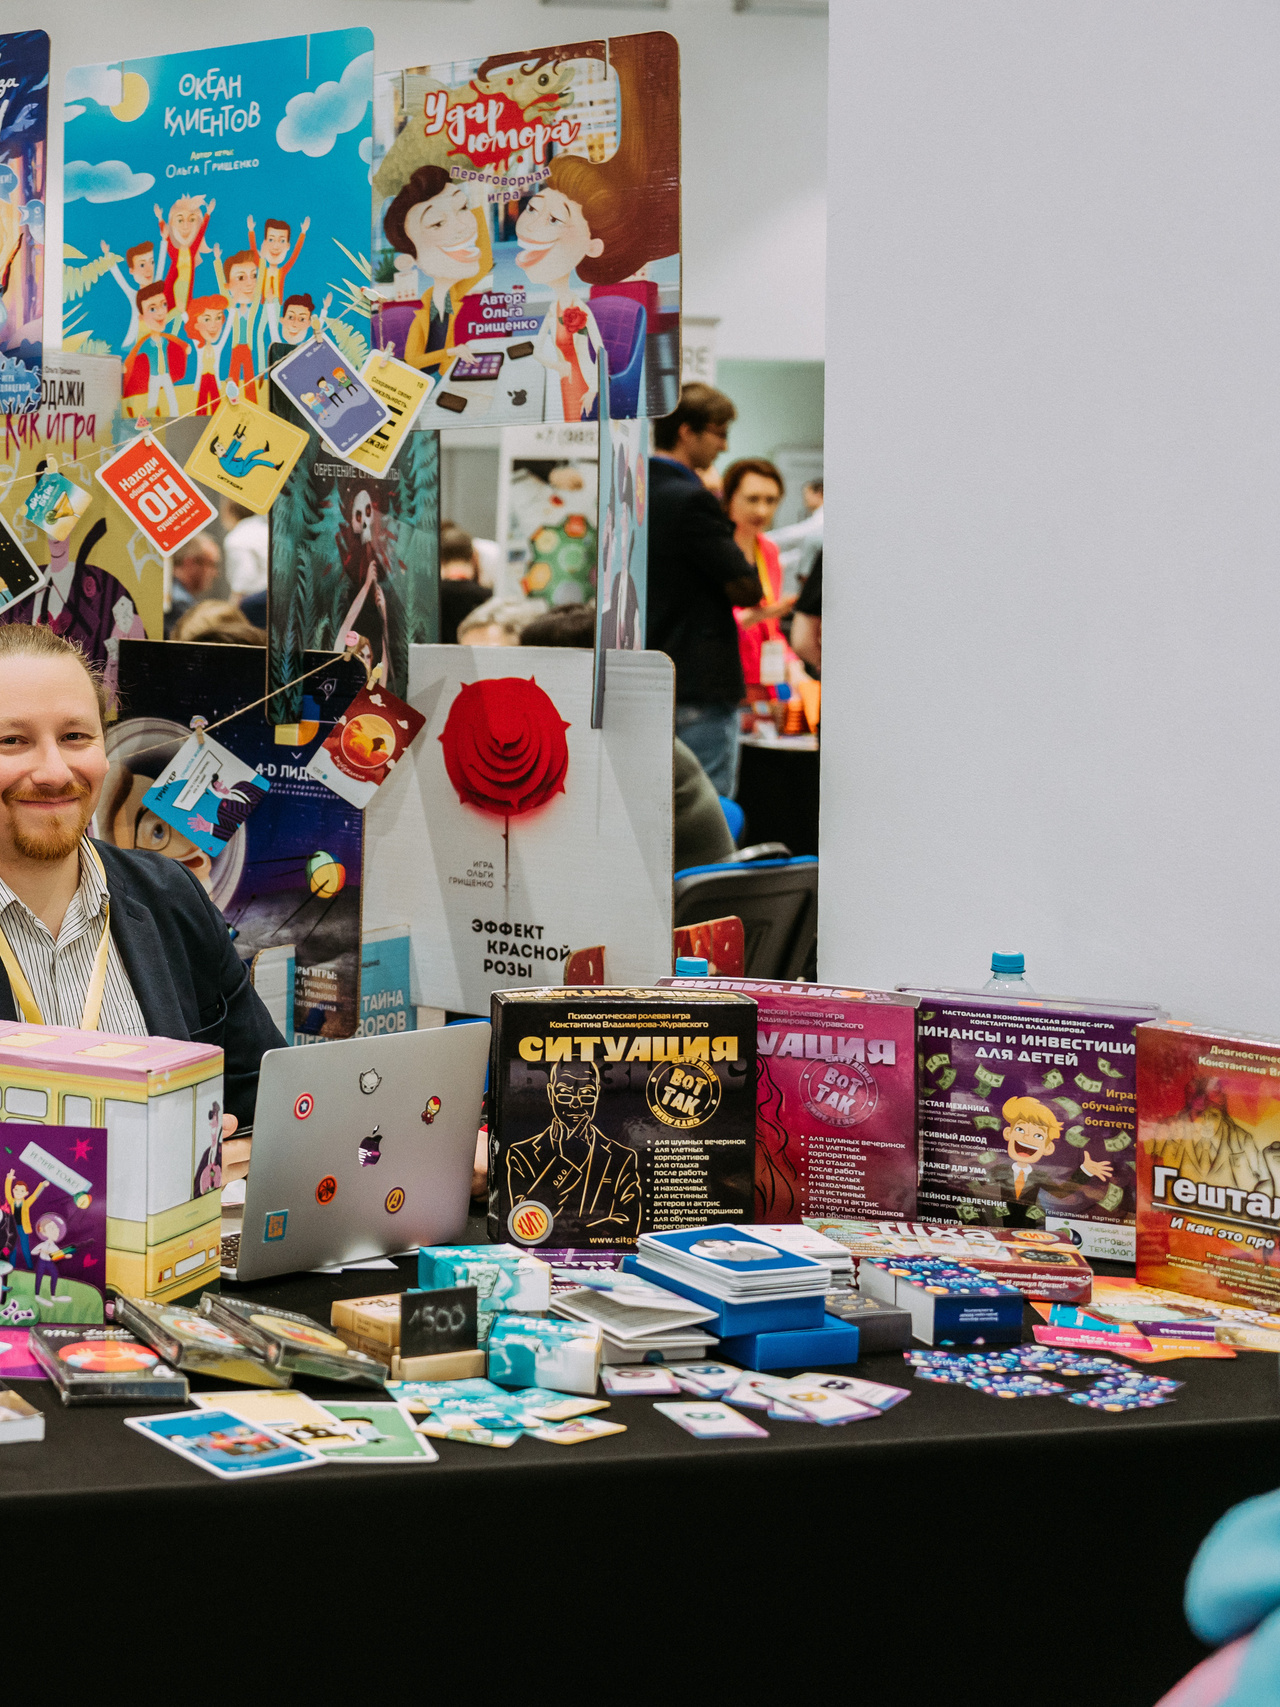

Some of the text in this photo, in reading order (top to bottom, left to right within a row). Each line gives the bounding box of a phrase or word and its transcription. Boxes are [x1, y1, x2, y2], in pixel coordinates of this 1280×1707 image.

[179, 68, 241, 101] ОКЕАН
[164, 101, 261, 137] КЛИЕНТОВ
[424, 90, 504, 145] Удар
[468, 119, 582, 164] юмора
[450, 165, 552, 187] Переговорная
[487, 190, 520, 203] игра
[479, 292, 526, 306] Автор:
[482, 306, 523, 320] Ольга
[468, 319, 538, 335] Грищенко
[42, 380, 85, 410] ОДАЖИ
[118, 457, 159, 492] Находи
[137, 474, 188, 523] ОН
[156, 498, 195, 532] существует!
[155, 771, 177, 801] ТРИГГЕР
[472, 860, 494, 869] ИГРА
[466, 869, 494, 879] ОЛЬГИ
[448, 877, 494, 888] ГРИЩЕНКО
[472, 918, 544, 940] ЭФФЕКТ
[487, 940, 570, 962] КРАСНОЙ
[311, 967, 337, 980] ИГРЫ:
[483, 959, 532, 978] РОЗЫ
[362, 989, 404, 1012] ТАЙНА
[568, 1012, 637, 1020] Психологическая
[789, 1010, 823, 1018] ролевая
[825, 1012, 844, 1020] игра
[942, 1010, 1114, 1029] НАСТОЛЬНАЯ ЭКОНОМИЧЕСКАЯ БИЗНЕС-ИГРА
[602, 1021, 709, 1029] Владимирова-Журавского
[970, 1019, 1085, 1034] КОНСТАНТИНА ВЛАДИМИРОВА
[918, 1026, 1001, 1044] ИНАНСЫ
[518, 1036, 738, 1062] СИТУАЦИЯ
[975, 1047, 1078, 1067] ДЛЯ ДЕТЕЙ
[672, 1056, 717, 1082] СИТУАЦИЯ
[1198, 1056, 1266, 1076] Константина
[670, 1067, 707, 1097] ВОТ
[823, 1067, 863, 1097] ВОТ
[662, 1087, 701, 1116] ТАК
[816, 1083, 856, 1116] ТАК
[946, 1102, 990, 1113] МЕХАНИКА
[1085, 1117, 1135, 1130] богатеть
[670, 1138, 703, 1146] шумных
[825, 1136, 906, 1149] шумных вечеринок
[959, 1134, 987, 1145] ДОХОД
[825, 1144, 860, 1152] улетных
[808, 1150, 867, 1161] корпоративов
[826, 1159, 856, 1167] отдыха
[951, 1164, 987, 1175] ДЛЯ УМА
[678, 1169, 708, 1177] работы
[808, 1165, 865, 1176] после работы
[826, 1174, 861, 1183] веселых
[815, 1181, 865, 1191] находчивых
[826, 1189, 866, 1198] истинных
[809, 1195, 879, 1208] актеров актрис
[952, 1195, 1007, 1208] РАЗВЛЕЧЕНИЕ
[699, 1207, 743, 1215] спорщиков
[828, 1204, 904, 1217] крутых спорщиков
[1045, 1208, 1120, 1223] Генеральный партнер
[518, 1212, 544, 1236] ХИТ!
[943, 1218, 963, 1226] ИГРА
[589, 1235, 637, 1244] www.sitga
[1170, 1217, 1275, 1249] И как это про
[1093, 1236, 1133, 1247] ИГРОВЫХ
[408, 1304, 466, 1332] 1500
